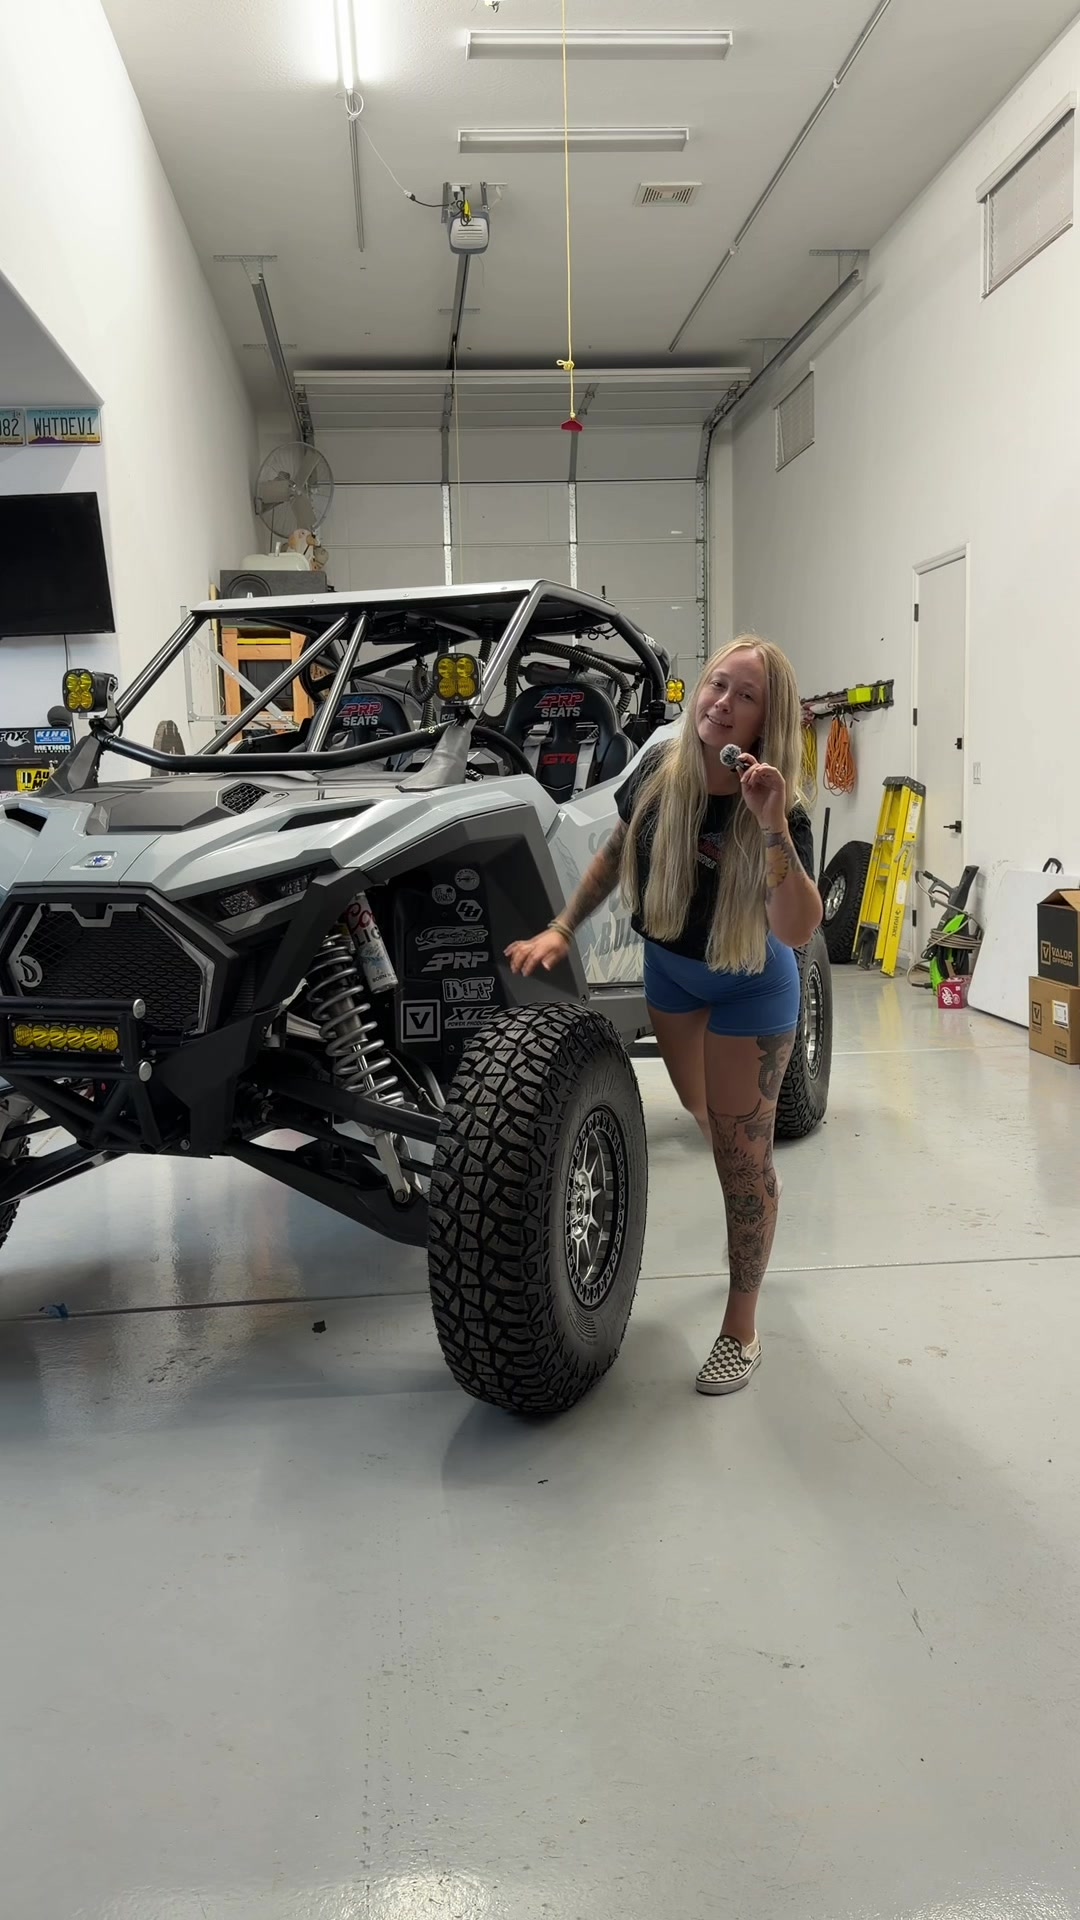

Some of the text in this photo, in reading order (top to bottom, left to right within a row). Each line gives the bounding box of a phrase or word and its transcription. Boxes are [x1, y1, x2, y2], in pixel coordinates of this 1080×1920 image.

[33, 417, 95, 436] WHTDEV1
[534, 692, 585, 708] PRP
[336, 702, 383, 717] PRP
[541, 707, 580, 718] SEATS
[343, 716, 378, 726] SEATS
[0, 731, 29, 745] FOX
[1051, 946, 1073, 961] VALOR
[421, 952, 489, 972] PRP
[448, 1007, 496, 1021] XTC
